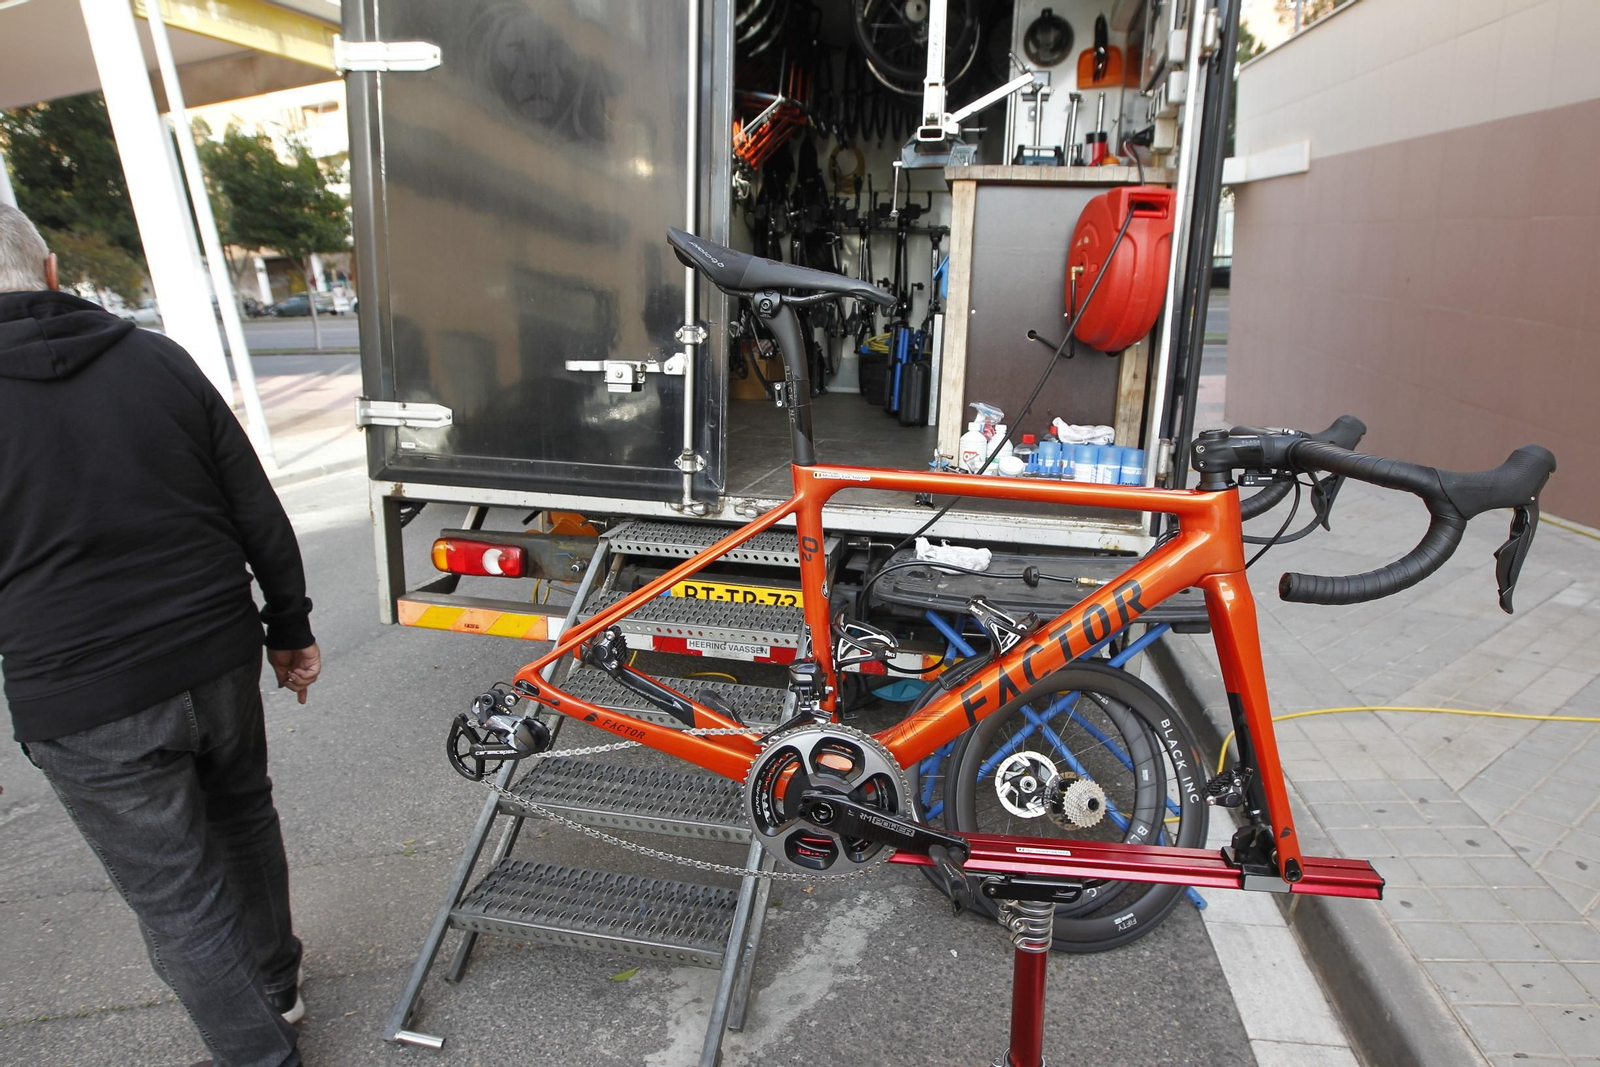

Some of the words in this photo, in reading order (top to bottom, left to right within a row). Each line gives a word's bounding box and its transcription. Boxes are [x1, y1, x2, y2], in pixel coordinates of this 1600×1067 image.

[688, 640, 727, 651] HEERING
[728, 644, 768, 655] VAASSEN
[961, 579, 1148, 727] FACTOR
[602, 718, 647, 740] FACTOR
[1160, 718, 1188, 771] BLACK
[1182, 776, 1200, 804] INC
